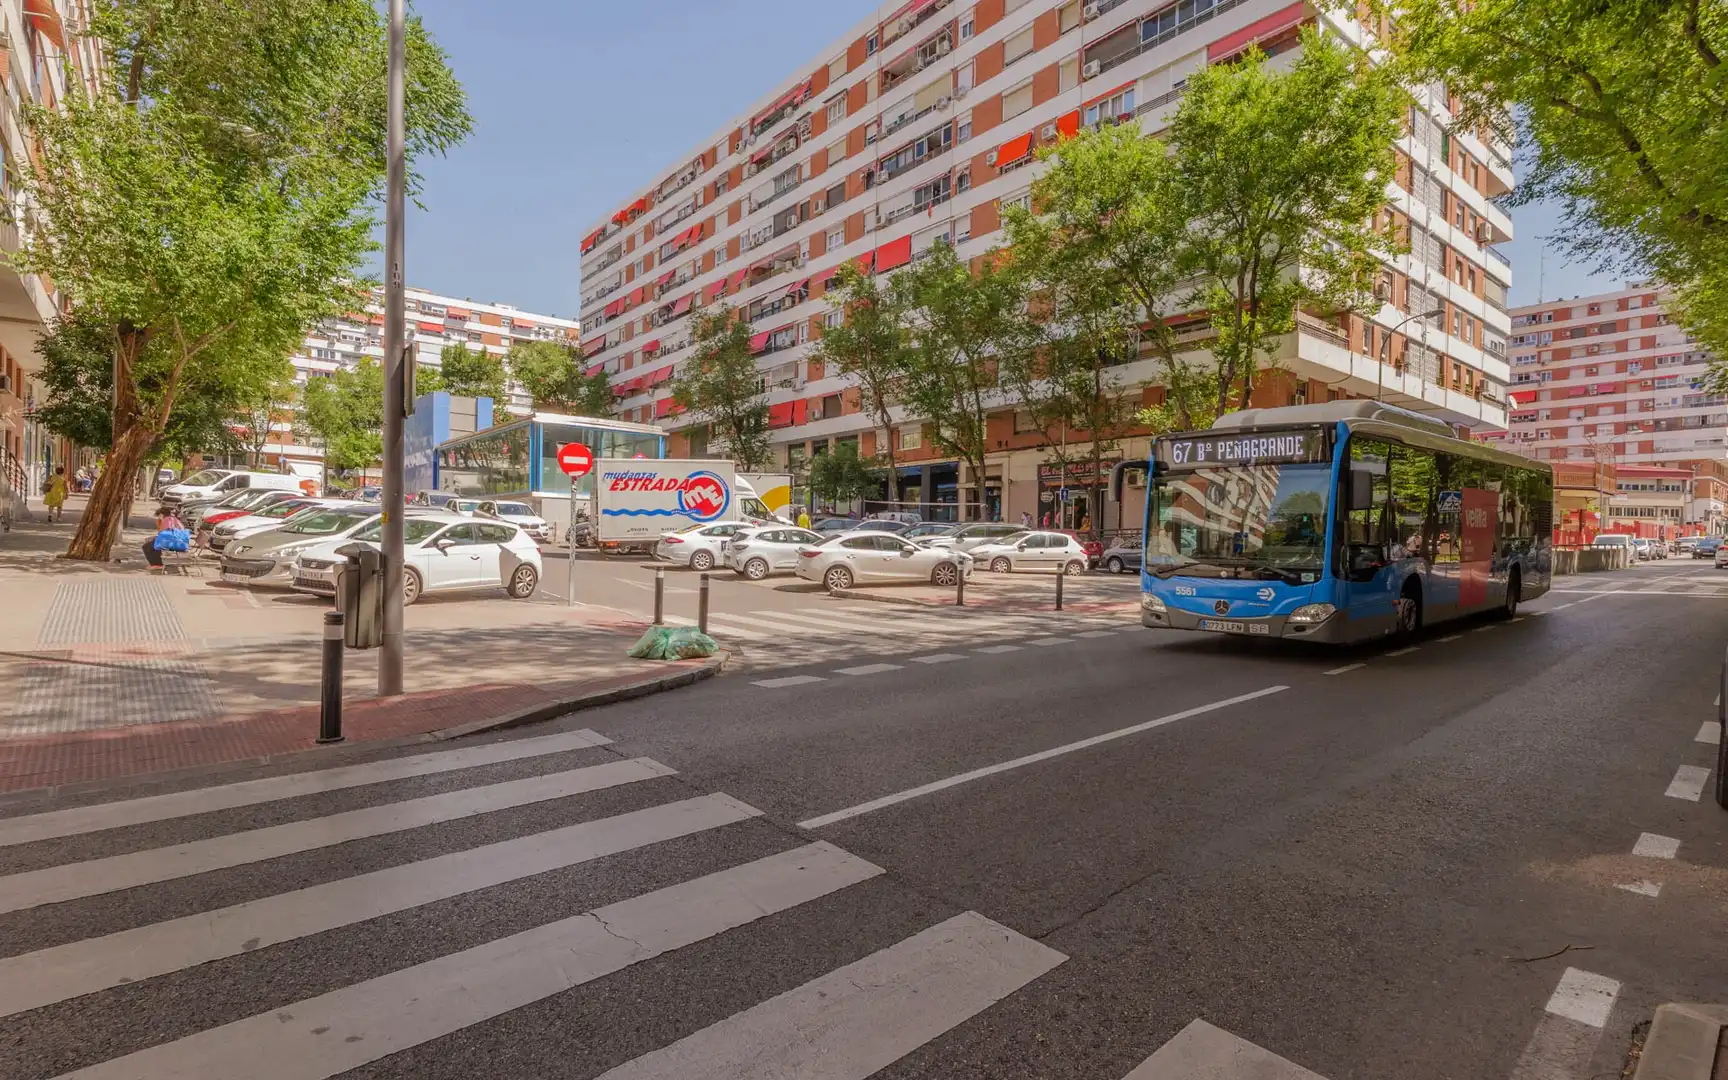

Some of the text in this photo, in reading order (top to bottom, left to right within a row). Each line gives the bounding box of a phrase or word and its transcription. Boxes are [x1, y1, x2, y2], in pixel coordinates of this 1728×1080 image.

[1172, 442, 1192, 464] 67
[1217, 436, 1304, 460] PEÑAGRANDE
[603, 470, 657, 481] mudanzas
[609, 479, 691, 492] ESTRADA
[1175, 586, 1196, 597] 5561
